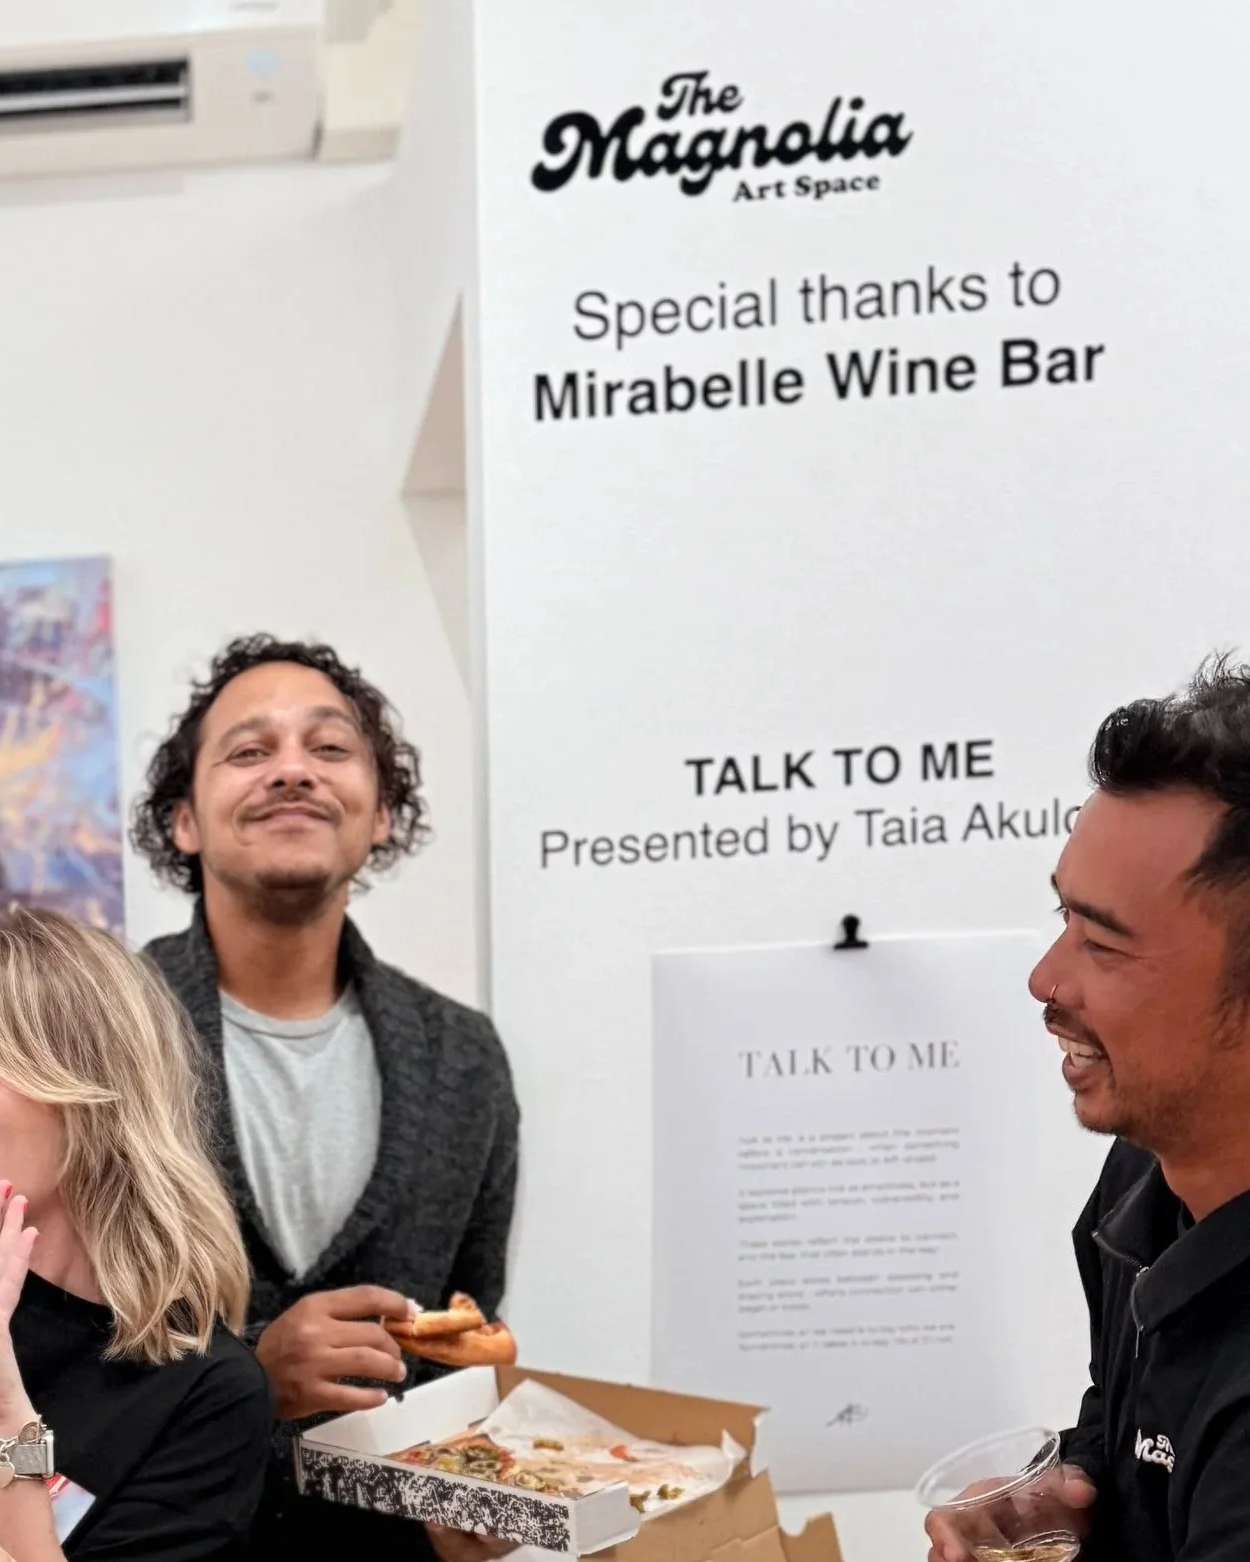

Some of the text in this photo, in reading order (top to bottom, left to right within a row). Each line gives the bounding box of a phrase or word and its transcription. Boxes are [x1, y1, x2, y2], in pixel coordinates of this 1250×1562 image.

[657, 70, 743, 121] The
[531, 97, 913, 196] Magnolia
[732, 174, 881, 203] Art Space
[573, 261, 1061, 352] Special thanks to
[533, 337, 1106, 423] Mirabelle Wine Bar
[683, 739, 995, 797] TALK TO ME
[540, 816, 770, 870] Presented
[787, 814, 840, 862] by
[853, 805, 949, 848] Taia
[738, 1040, 961, 1079] TALK TO ME
